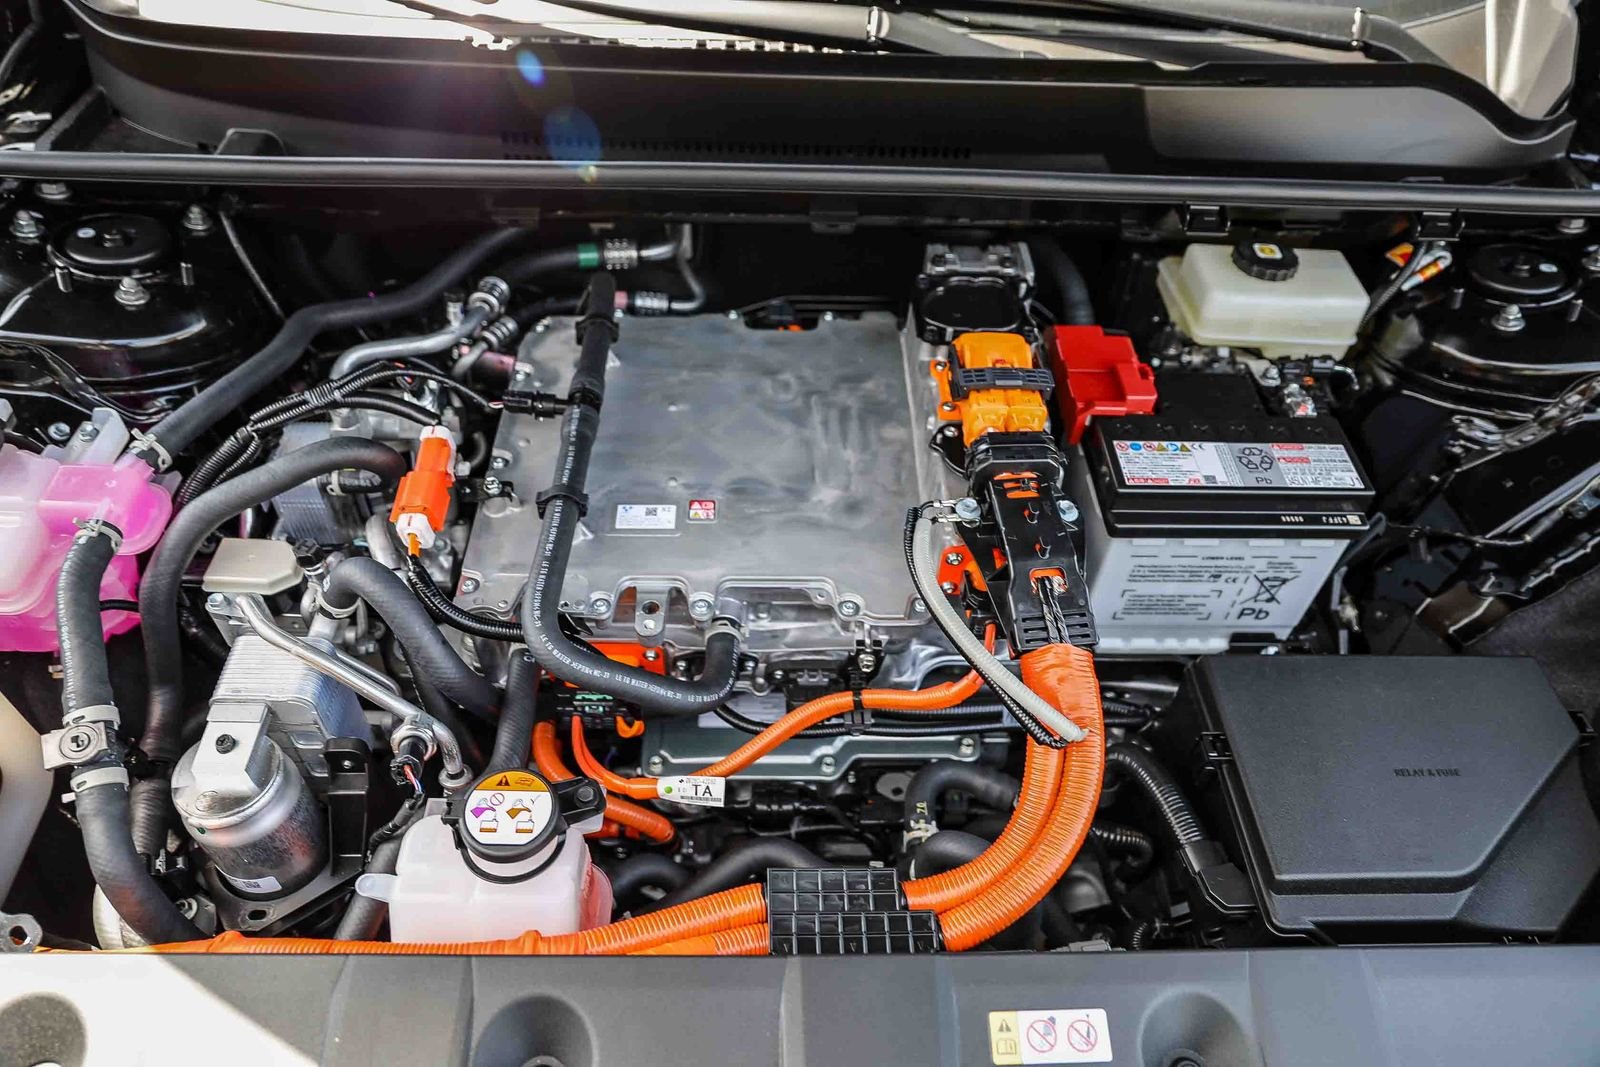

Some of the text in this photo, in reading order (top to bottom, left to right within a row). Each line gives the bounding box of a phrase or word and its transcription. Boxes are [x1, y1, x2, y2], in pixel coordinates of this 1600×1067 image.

[1255, 476, 1273, 485] Pb
[535, 575, 547, 591] WATER
[1237, 607, 1270, 620] Pb
[552, 649, 571, 665] WATER
[631, 679, 649, 690] WATER
[703, 693, 719, 703] WATER
[1393, 768, 1425, 777] RELAY
[692, 784, 713, 797] TA
